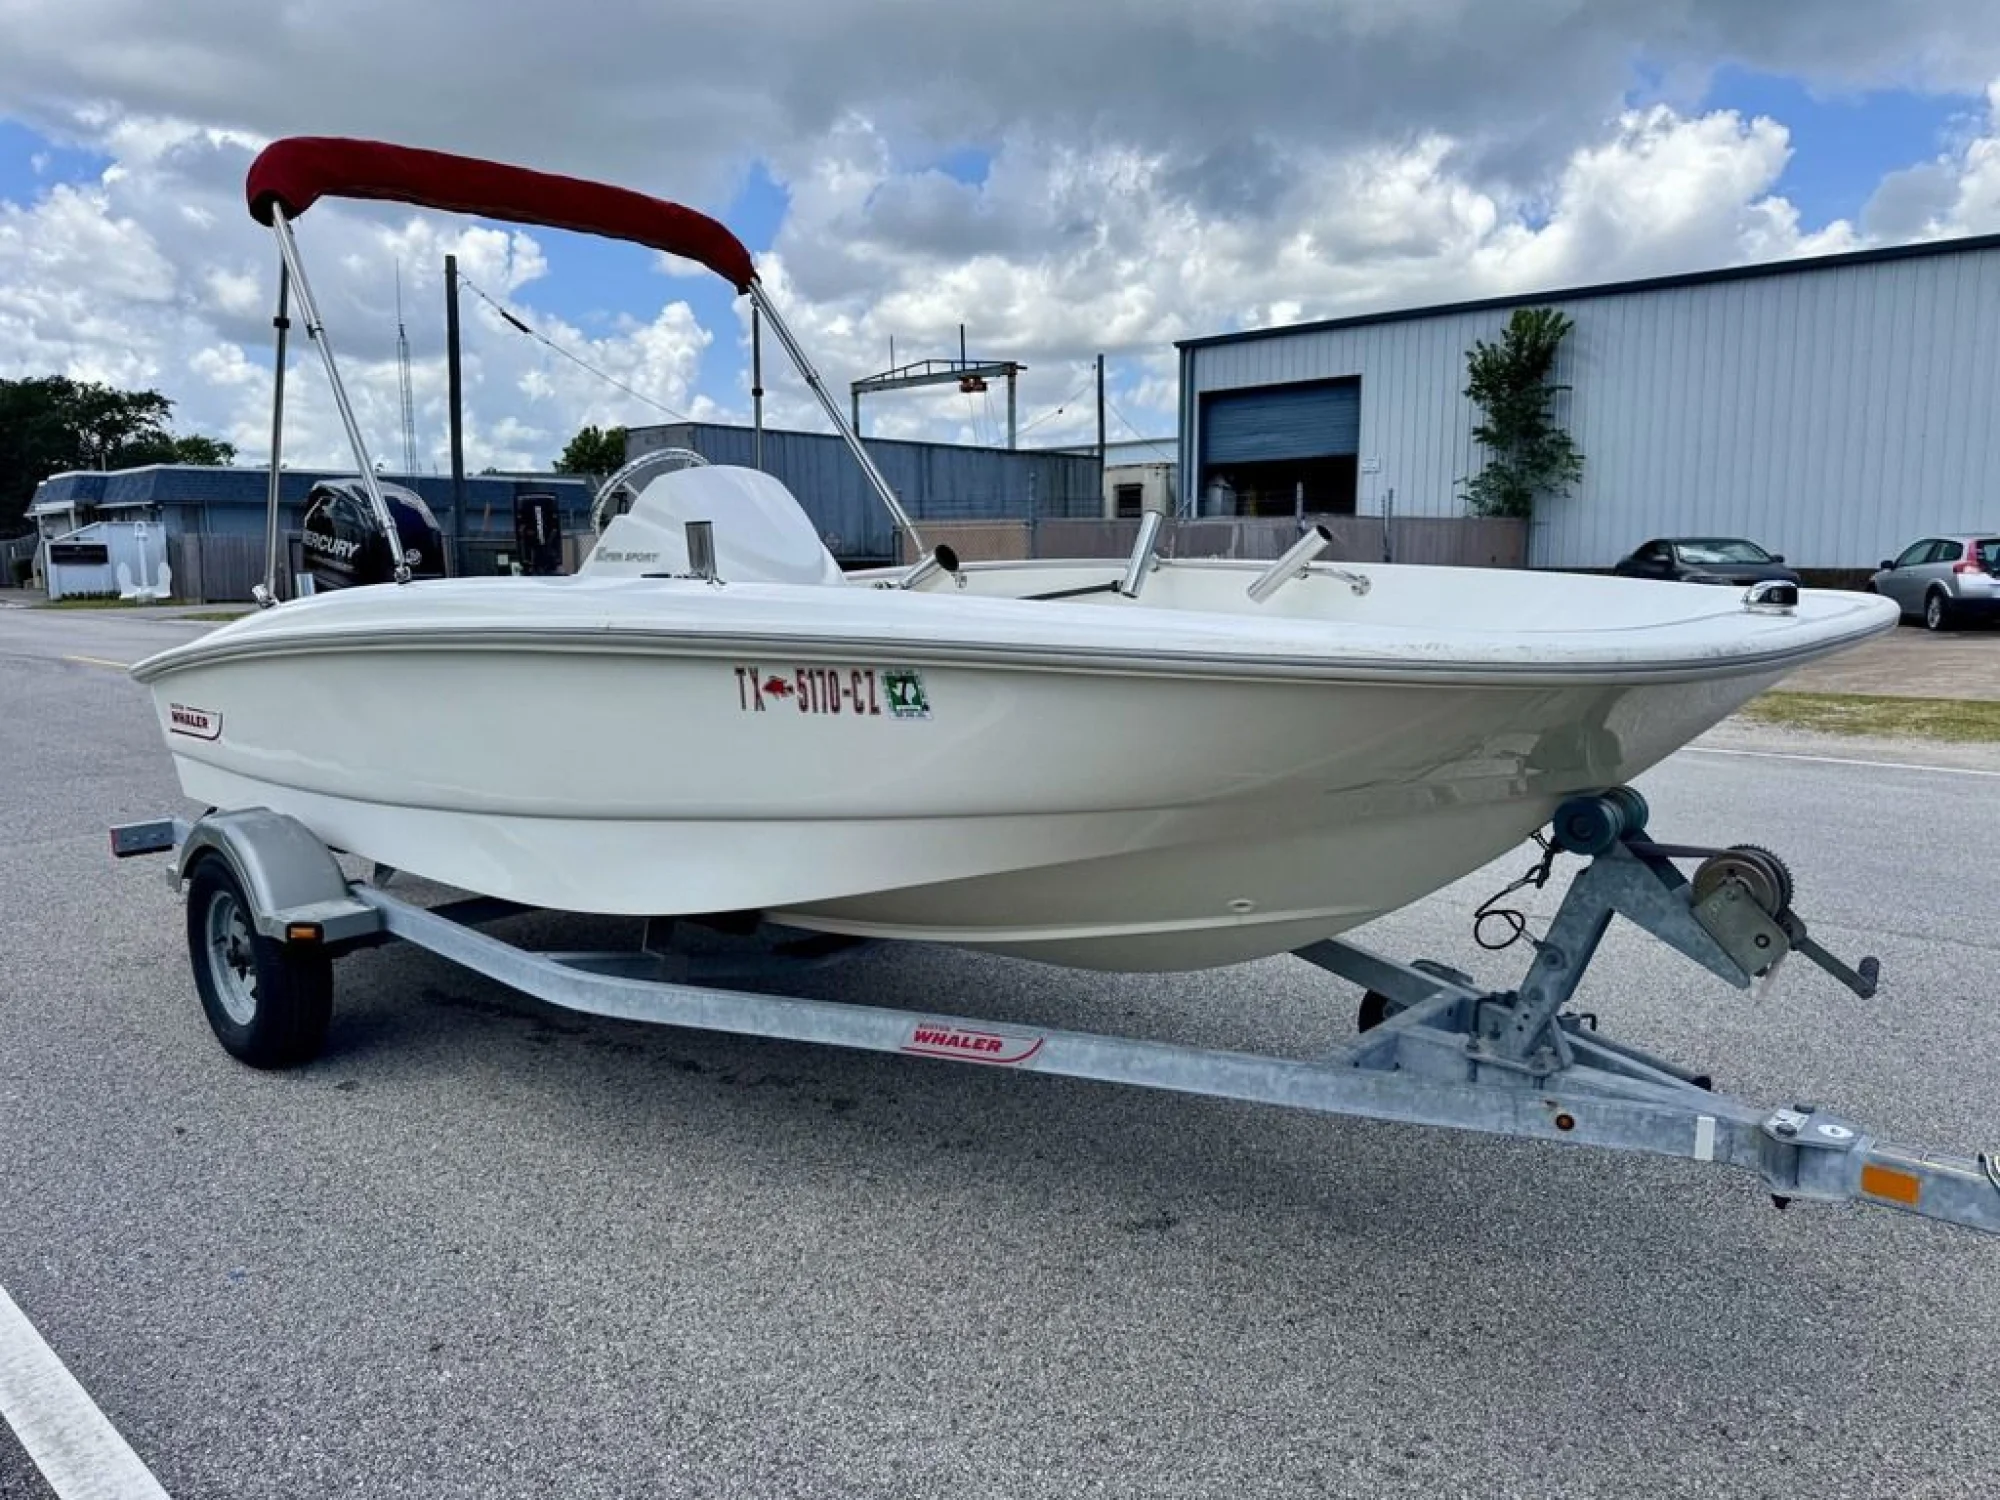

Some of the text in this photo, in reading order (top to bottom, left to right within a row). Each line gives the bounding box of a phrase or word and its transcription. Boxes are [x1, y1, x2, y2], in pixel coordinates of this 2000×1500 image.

[303, 530, 360, 558] ERCURY
[735, 667, 765, 711] TX
[171, 711, 208, 729] WHALER
[914, 1030, 1003, 1052] WHALER
